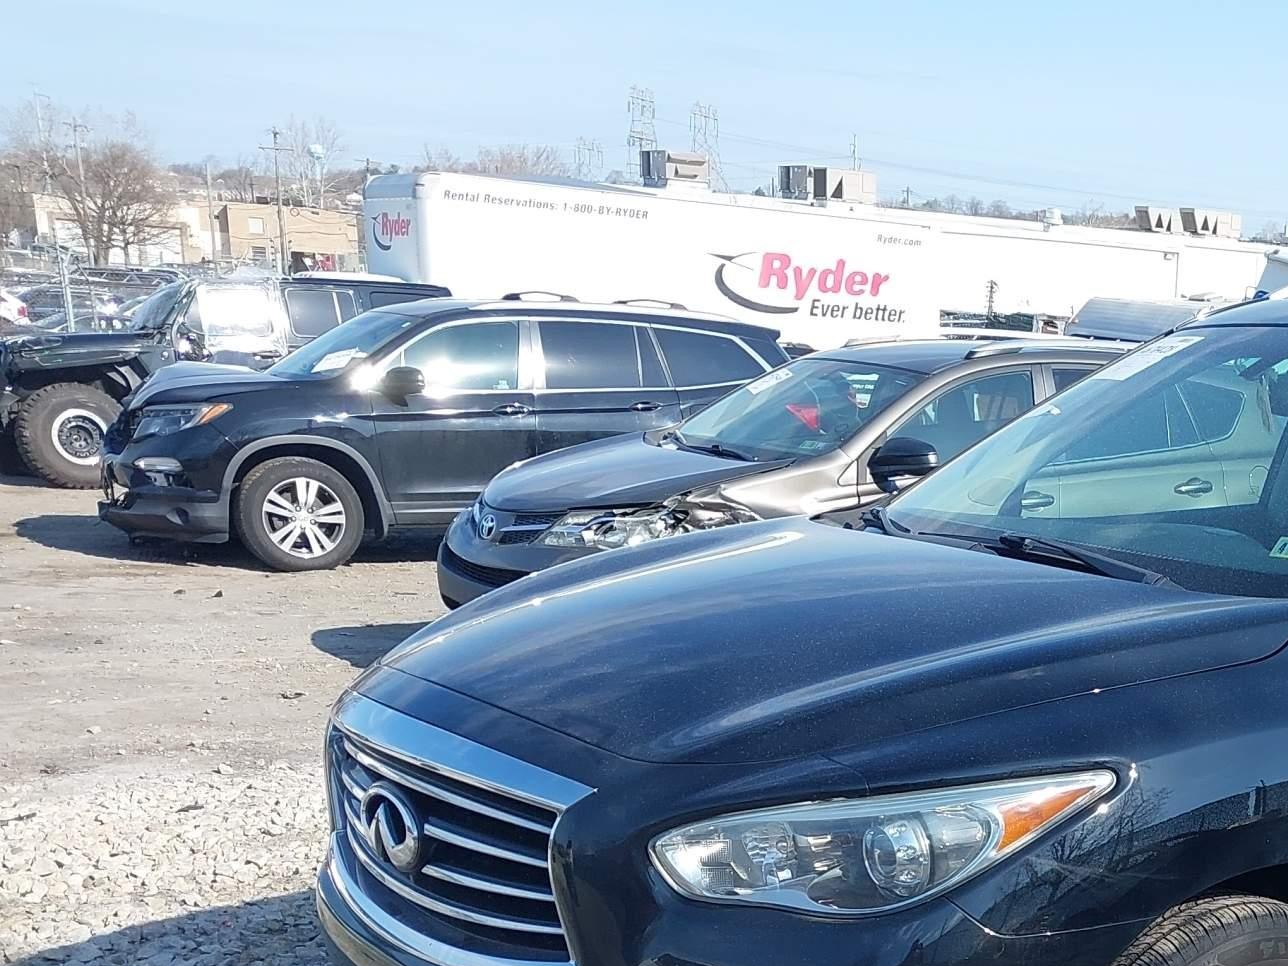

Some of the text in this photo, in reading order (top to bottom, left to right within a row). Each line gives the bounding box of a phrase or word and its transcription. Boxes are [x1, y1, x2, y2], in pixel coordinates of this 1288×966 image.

[443, 189, 650, 220] Rental Reservations: 1-800-BY-RYDER
[381, 211, 412, 243] Ryder
[877, 234, 922, 247] Ryder.com
[758, 252, 890, 300] Ryder
[809, 299, 906, 323] Ever better.
